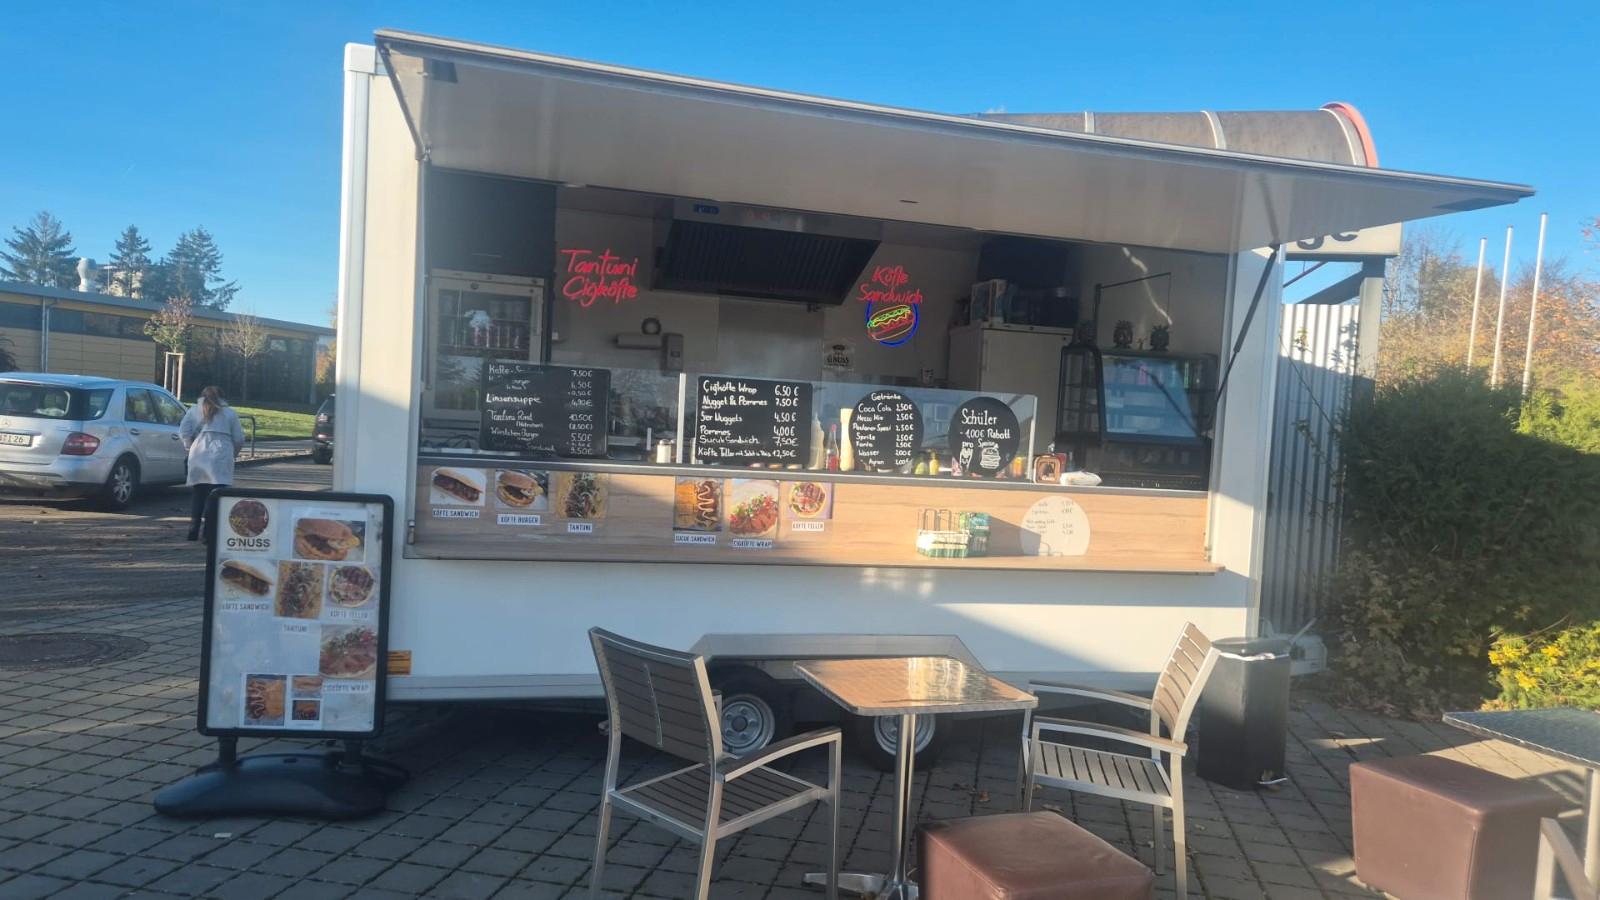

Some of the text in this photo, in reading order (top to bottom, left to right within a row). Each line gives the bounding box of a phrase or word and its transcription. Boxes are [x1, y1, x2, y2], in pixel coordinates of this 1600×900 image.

[560, 248, 639, 277] Tantuni
[857, 283, 923, 304] Sandwich
[738, 381, 758, 395] Wrap
[793, 386, 800, 396] €
[486, 393, 543, 405] Linsensuppe
[738, 395, 769, 406] Pommes
[858, 402, 876, 413] Coca
[877, 402, 892, 412] Cola
[961, 407, 998, 426] Schüler
[700, 424, 732, 437] Pommes
[987, 427, 1011, 440] Rabatt
[855, 432, 876, 441] Sprite
[855, 440, 873, 448] Fanta
[961, 441, 974, 449] pro
[858, 449, 880, 457] Wasser
[868, 457, 885, 467] Ayran
[227, 537, 271, 548] G'NUSS
